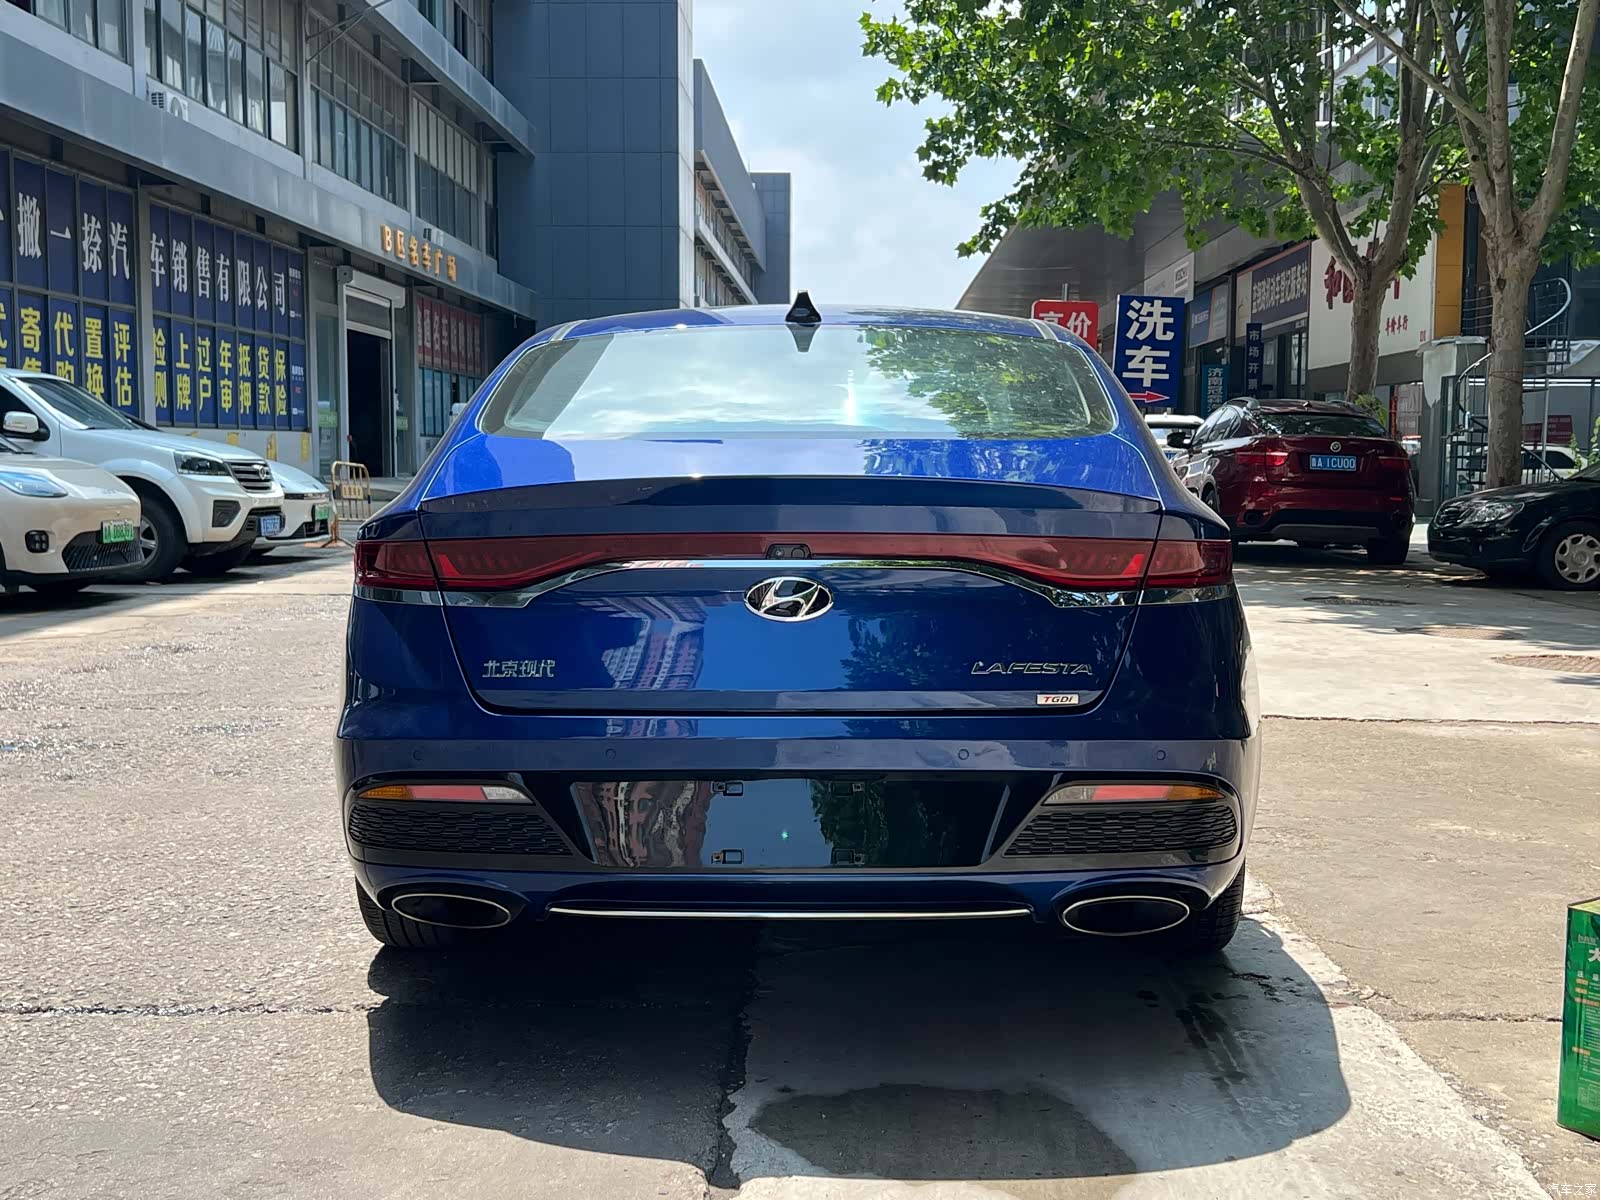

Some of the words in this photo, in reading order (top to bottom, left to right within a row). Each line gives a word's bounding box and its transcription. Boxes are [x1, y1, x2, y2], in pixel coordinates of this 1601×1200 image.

[85, 317, 104, 401] 置换
[114, 321, 132, 408] 评估
[176, 333, 191, 411] 上牌
[197, 335, 212, 411] 过户
[219, 340, 232, 413] 年审
[238, 343, 252, 414] 抵押
[1122, 300, 1175, 387] 洗车
[1248, 330, 1260, 398] 市场开票
[258, 346, 270, 415] 贷款
[275, 350, 287, 416] 保险
[482, 660, 556, 677] 北京现代
[971, 661, 1093, 675] LAFESTA
